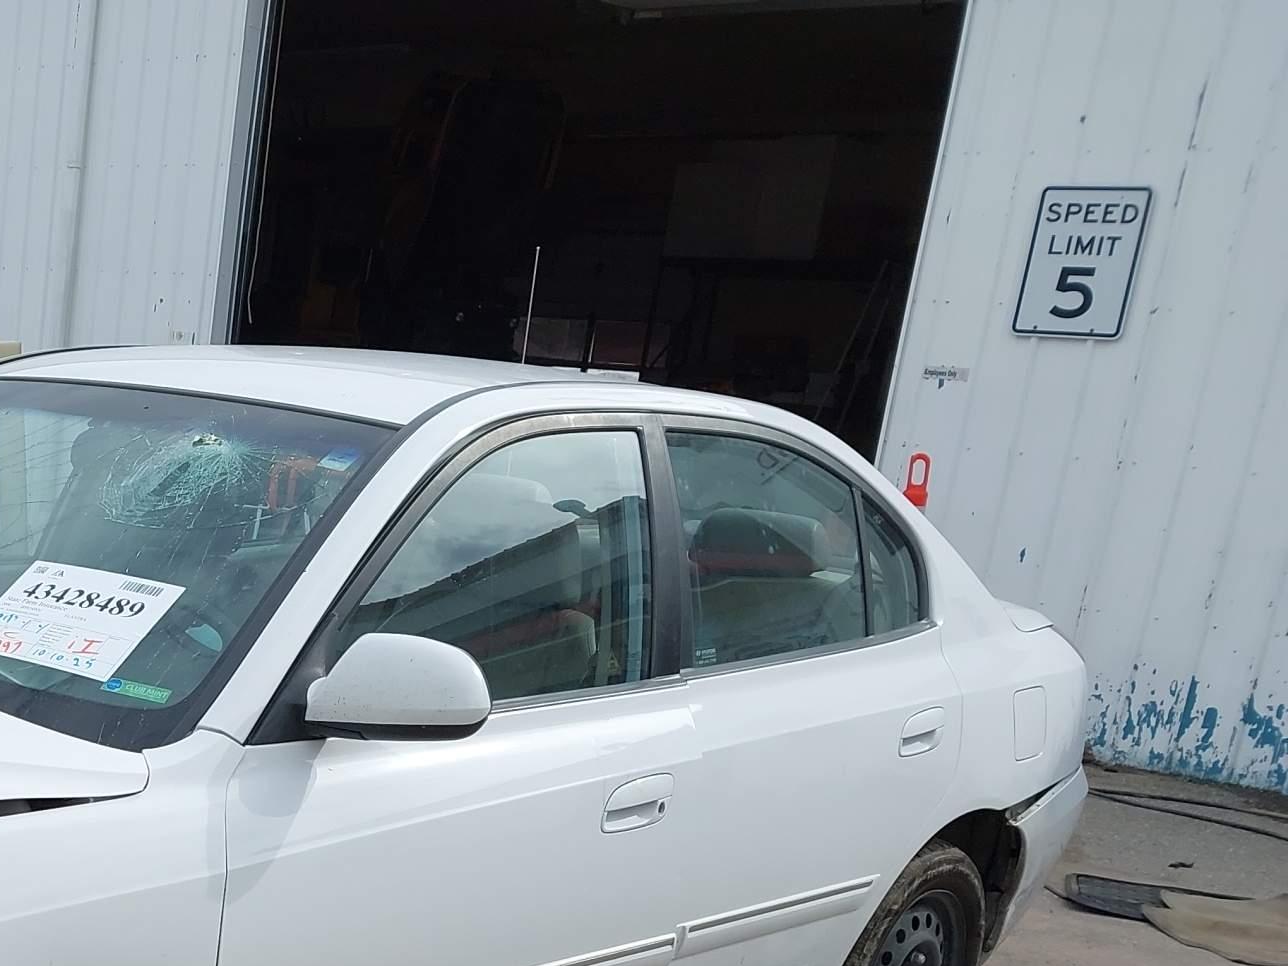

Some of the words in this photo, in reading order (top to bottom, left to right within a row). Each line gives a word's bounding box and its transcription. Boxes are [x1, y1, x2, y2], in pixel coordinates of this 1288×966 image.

[1045, 202, 1140, 224] SPEED
[1047, 234, 1122, 256] LIMIT
[1048, 266, 1097, 319] 5
[22, 582, 146, 618] 43428489
